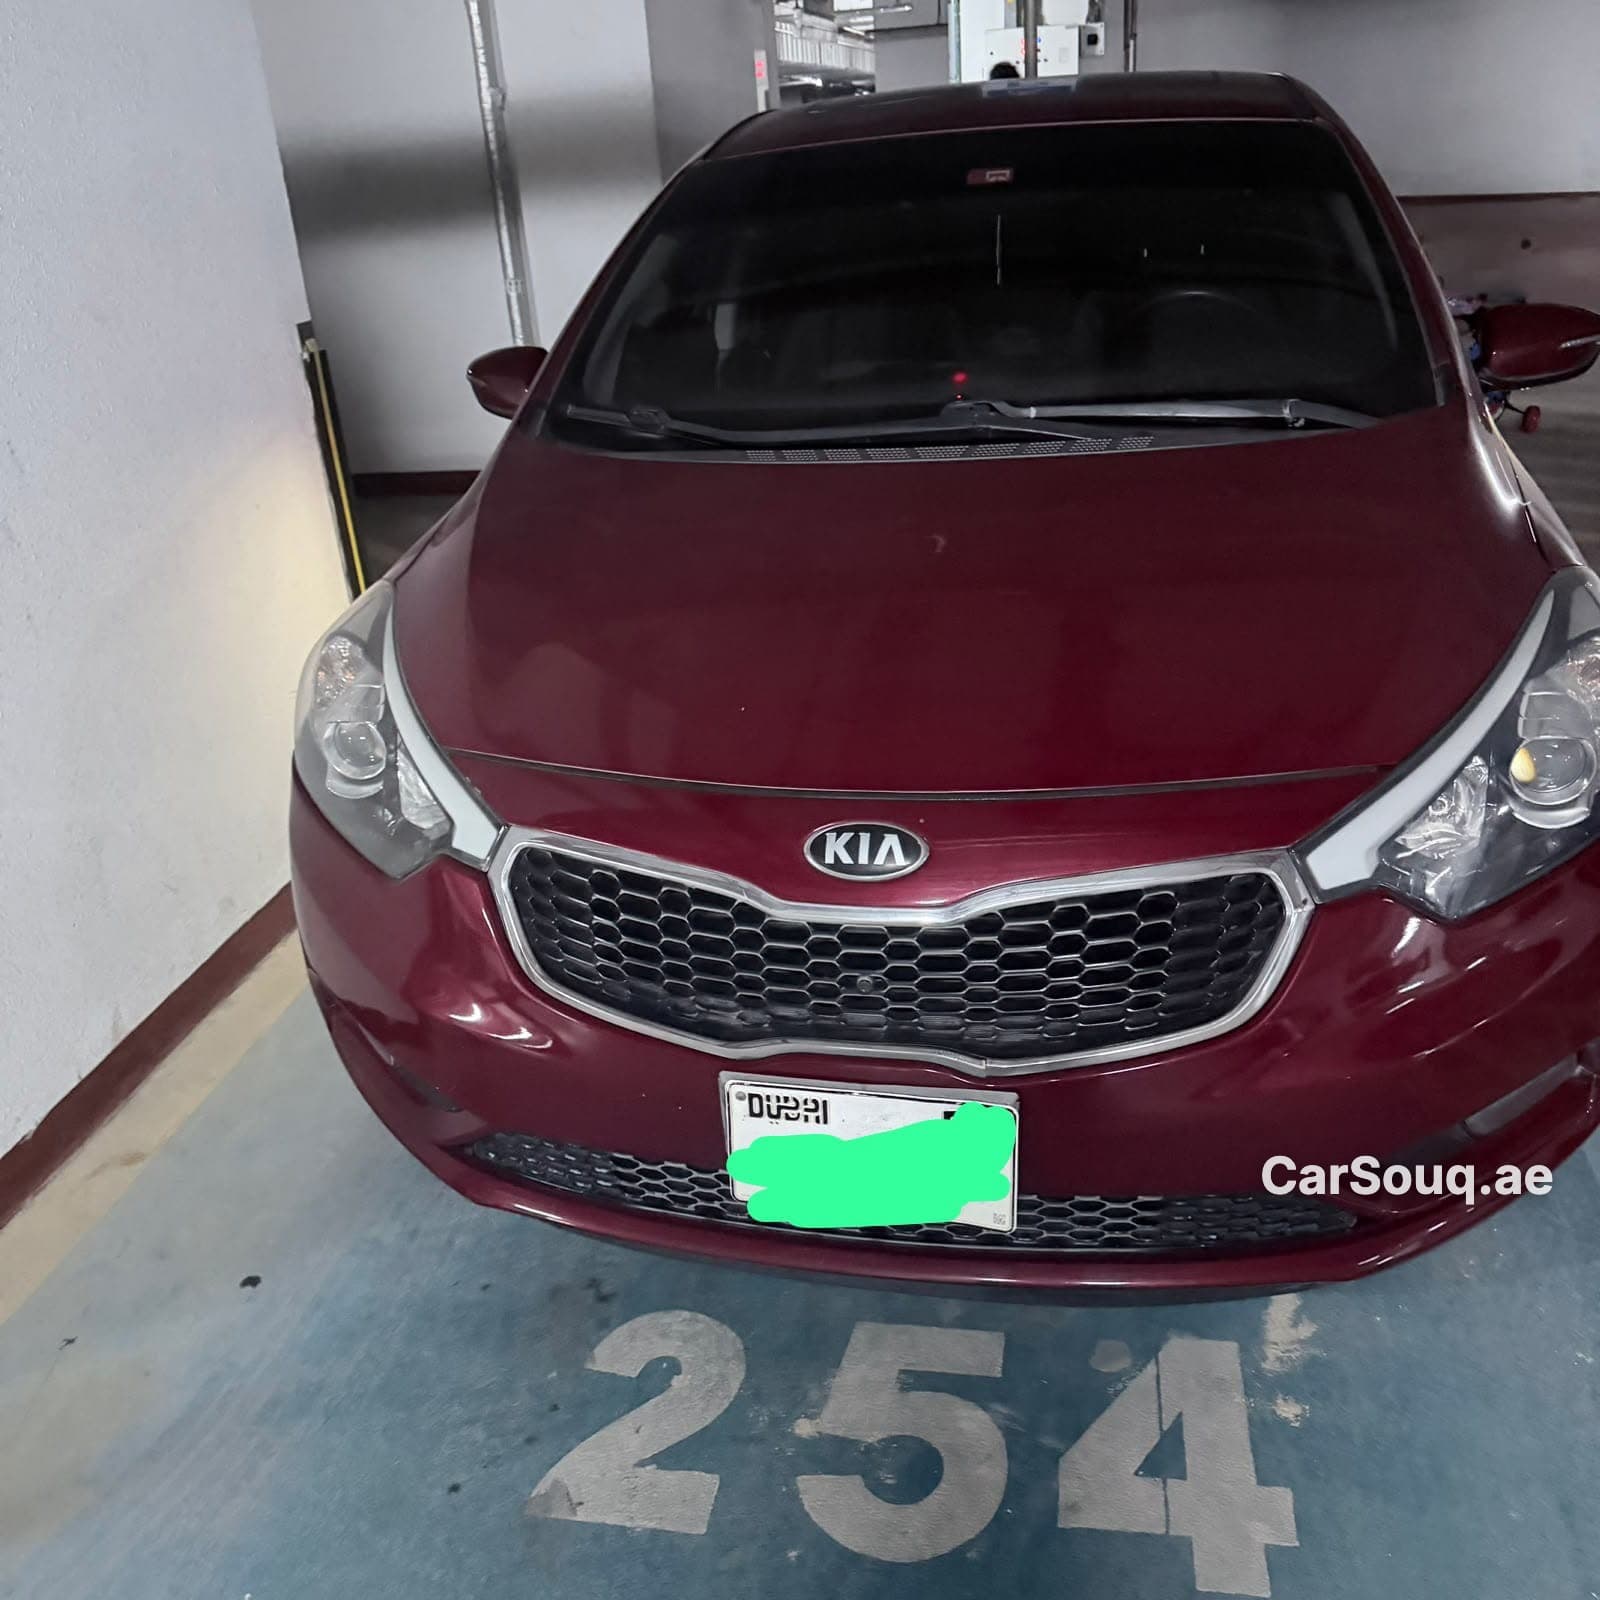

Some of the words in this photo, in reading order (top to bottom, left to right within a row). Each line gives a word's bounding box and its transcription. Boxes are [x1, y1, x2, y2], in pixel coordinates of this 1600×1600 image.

[824, 832, 906, 866] KIA
[747, 1092, 828, 1125] DUBAI
[524, 1309, 1300, 1598] 254
